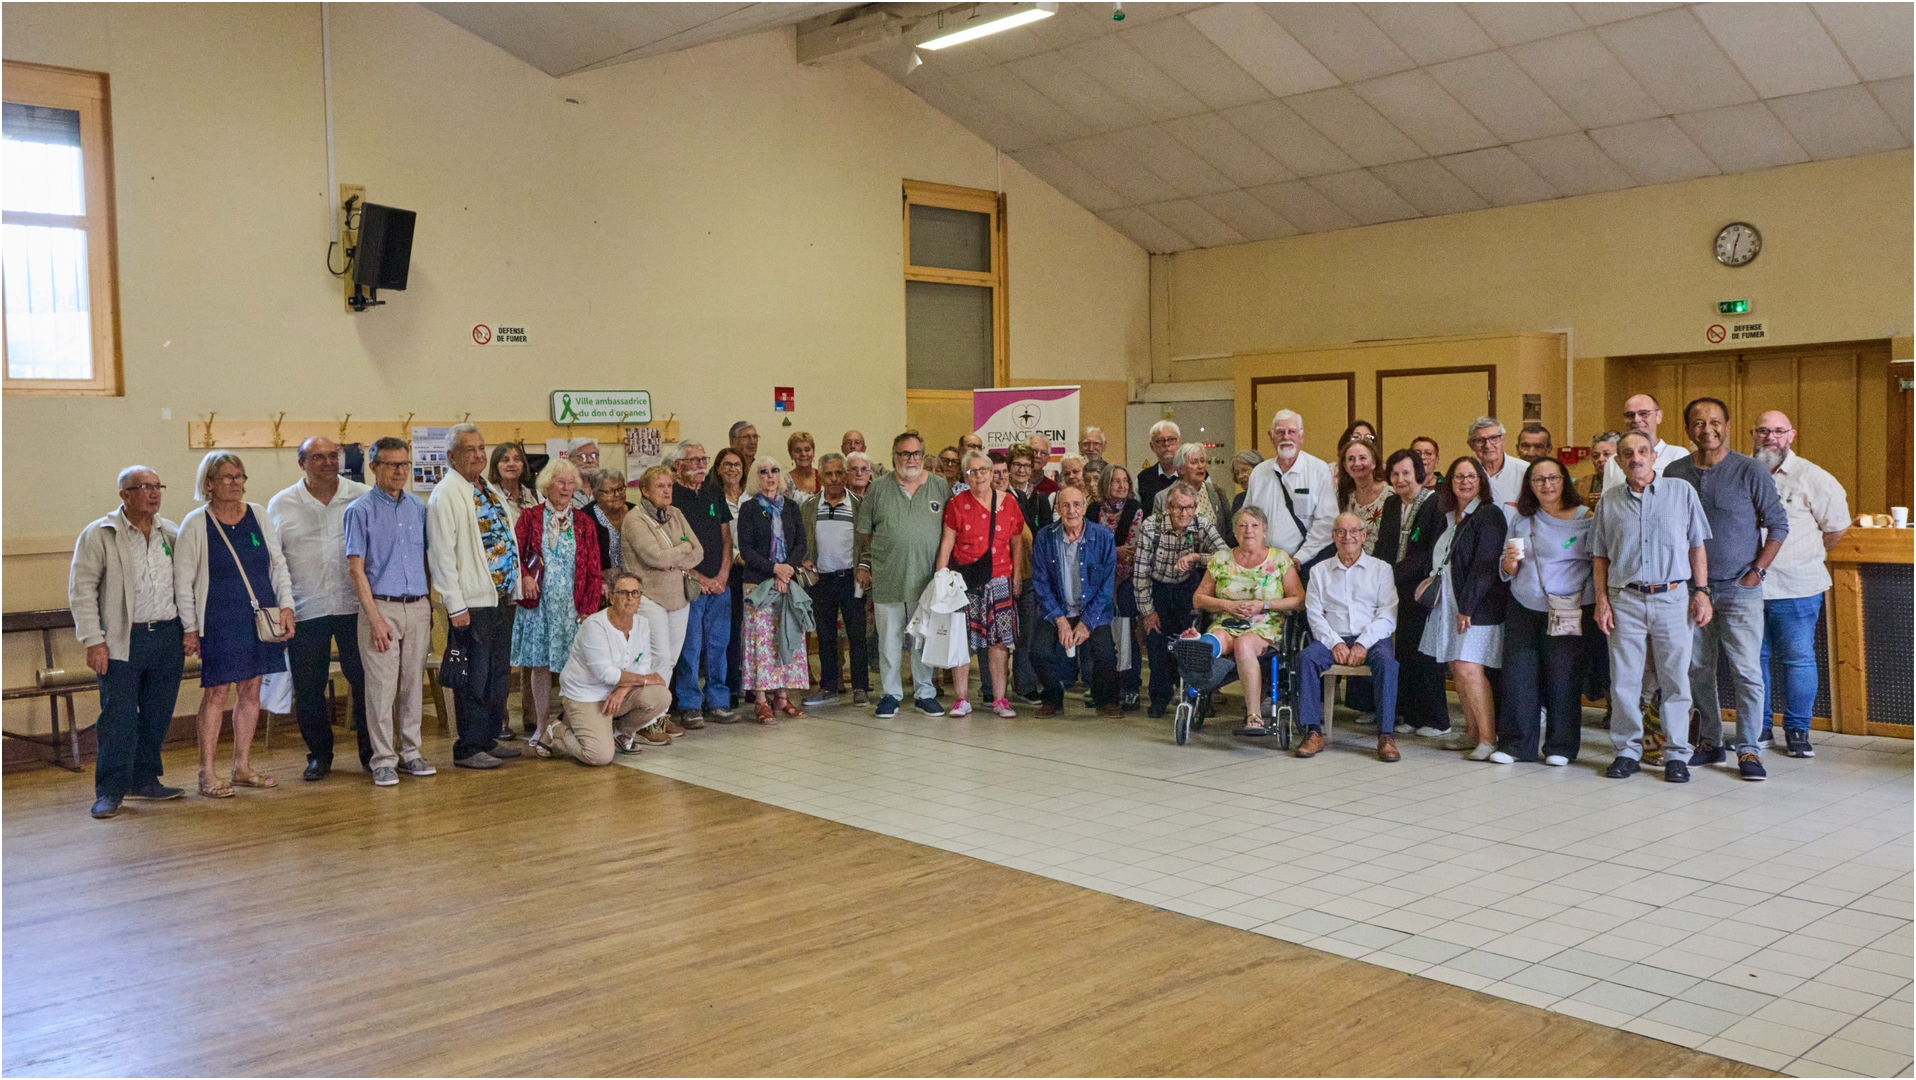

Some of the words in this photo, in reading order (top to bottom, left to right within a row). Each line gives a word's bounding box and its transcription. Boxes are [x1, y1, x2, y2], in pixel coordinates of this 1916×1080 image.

[1734, 324, 1762, 332] DEFENSE
[1742, 331, 1765, 339] FUMER
[595, 397, 647, 405] ambassadrice
[579, 409, 590, 417] du
[591, 408, 607, 417] don
